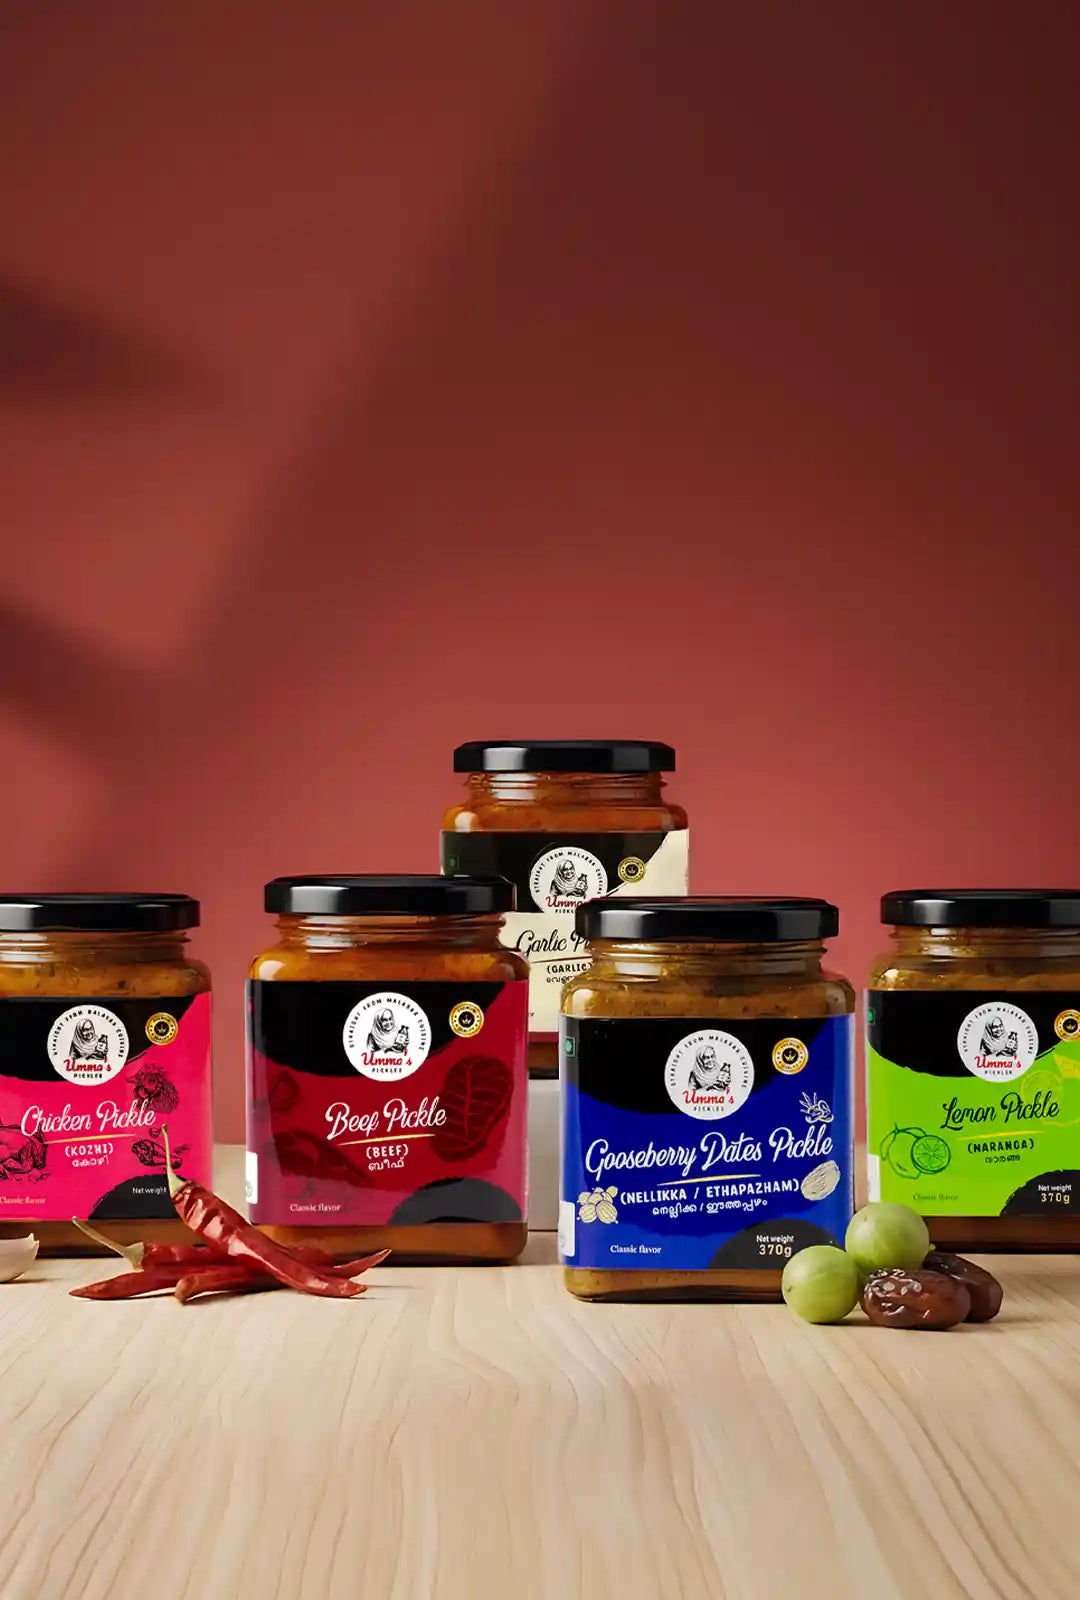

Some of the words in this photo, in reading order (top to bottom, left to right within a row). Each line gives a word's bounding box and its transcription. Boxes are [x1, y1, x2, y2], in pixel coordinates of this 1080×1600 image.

[545, 895, 587, 908] Umma'
[516, 929, 568, 957] Garlic
[63, 1057, 112, 1072] Umma's
[360, 1050, 413, 1066] Umma's
[974, 1055, 1022, 1069] Umma's
[682, 1087, 735, 1105] Umma's
[20, 1103, 92, 1137] Chicken
[96, 1099, 156, 1132] Pickle
[324, 1101, 379, 1141] Beef
[383, 1096, 447, 1133] Pickle
[940, 1097, 996, 1131] Lemon
[1000, 1091, 1060, 1123] Pickle
[65, 1142, 114, 1158] (KOZHI)
[366, 1143, 409, 1159] (BEEF)
[585, 1138, 697, 1182] Gooseberry
[700, 1131, 763, 1171] Dates
[769, 1124, 834, 1162] Pickle
[967, 1138, 1034, 1154] (NARANGA)
[620, 1186, 688, 1205] (NELLIKKA
[706, 1178, 799, 1198] ETHAPAZHAM)
[756, 1234, 769, 1243] Net
[770, 1234, 795, 1244] weight
[610, 1244, 637, 1253] Classic
[759, 1244, 792, 1258] 370g
